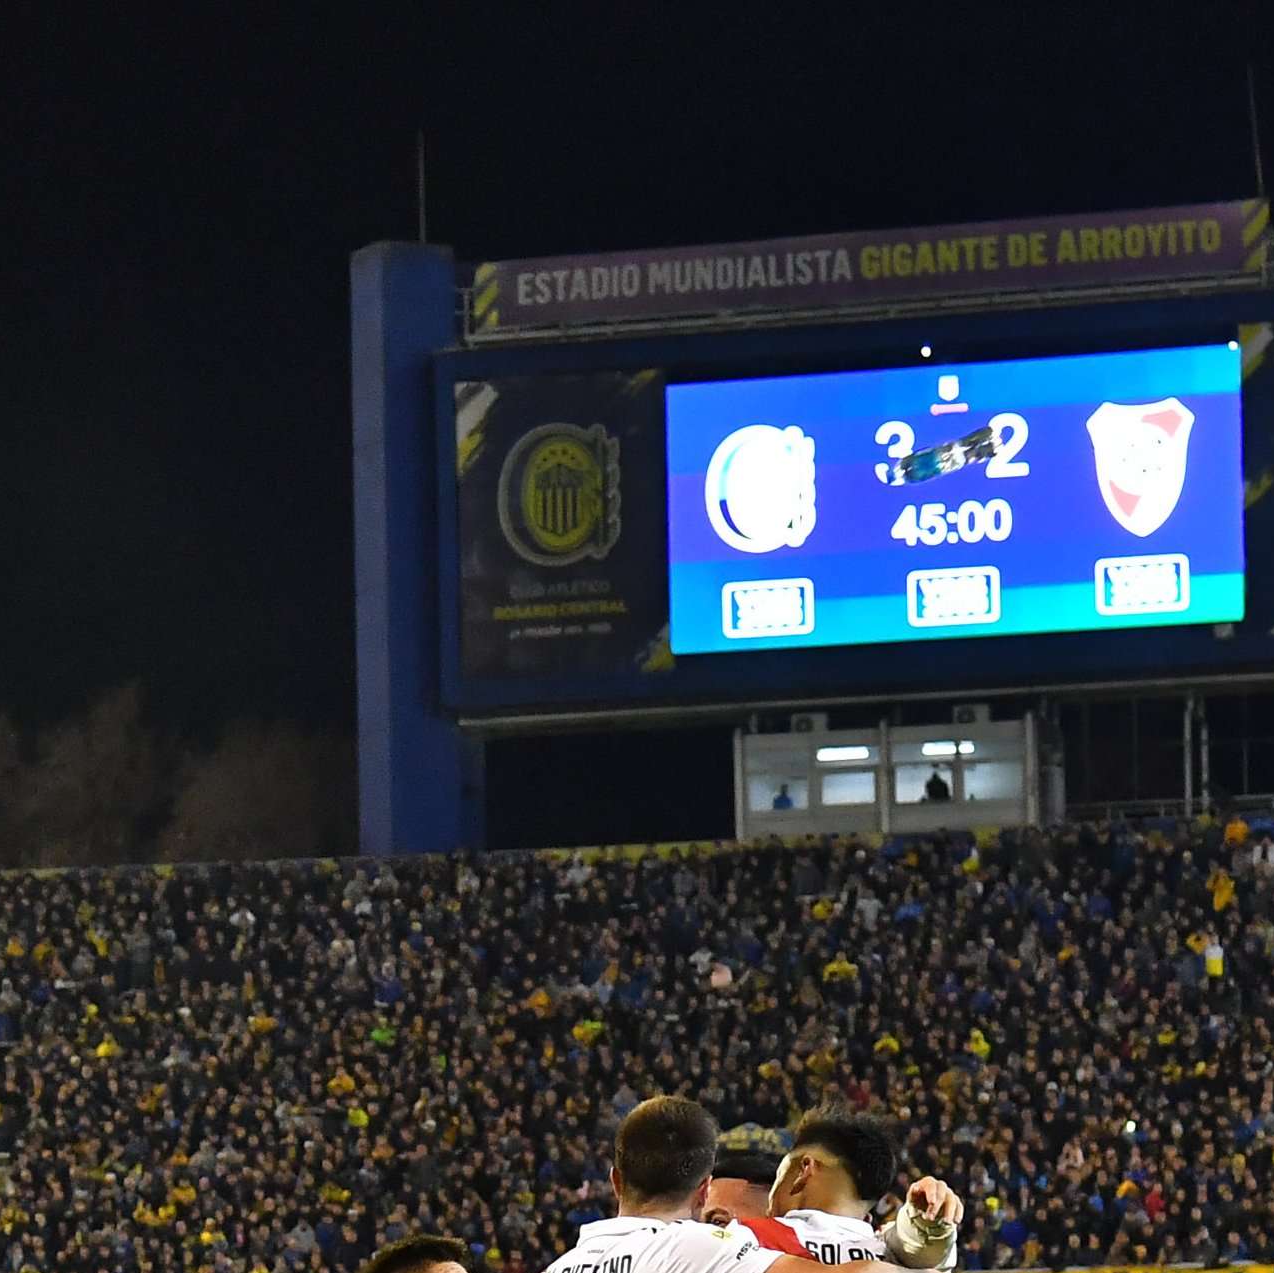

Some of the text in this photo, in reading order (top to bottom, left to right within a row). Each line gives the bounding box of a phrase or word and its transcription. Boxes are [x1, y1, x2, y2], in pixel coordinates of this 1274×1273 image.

[517, 219, 1222, 305] ESTADIO MUNDIALISTA GIGANTE DE ARROYITO
[874, 412, 1030, 487] 3 2
[890, 498, 1013, 547] 45:00
